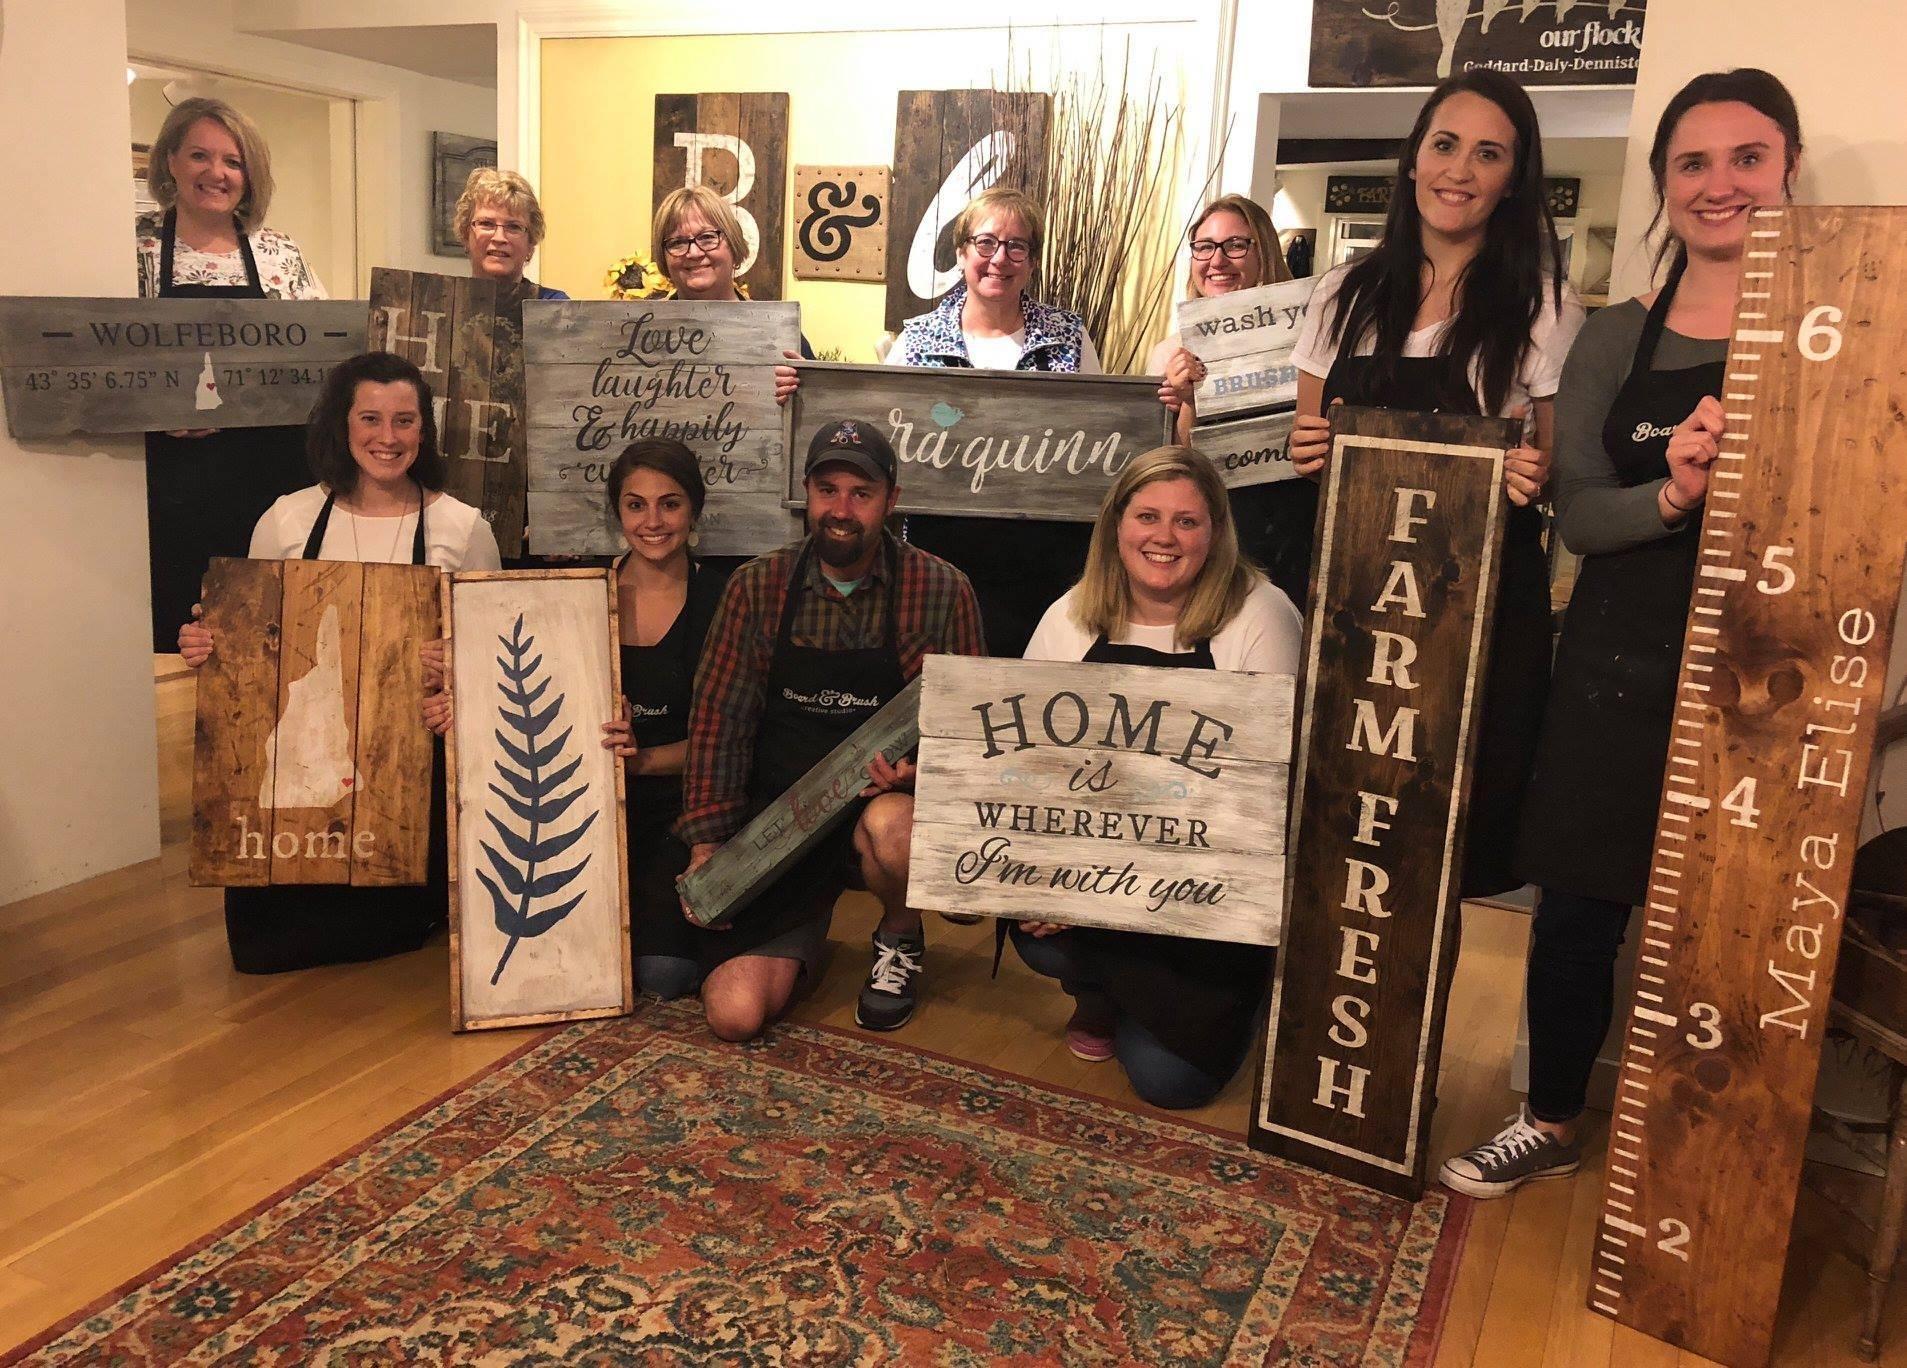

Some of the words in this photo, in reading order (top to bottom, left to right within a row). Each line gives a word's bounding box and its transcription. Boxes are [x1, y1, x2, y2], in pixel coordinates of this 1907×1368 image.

[1540, 30, 1580, 48] our
[673, 132, 760, 279] B
[799, 181, 881, 262] &
[89, 322, 308, 347] WOLFEBORO
[380, 306, 446, 374] H
[616, 312, 712, 368] Love
[1195, 305, 1277, 337] wash
[1797, 305, 1842, 361] 6
[165, 370, 179, 388] N
[592, 357, 737, 409] laughter
[572, 405, 616, 451] &
[620, 401, 750, 453] happily
[961, 427, 1132, 494] quinn
[1756, 545, 1796, 595] 5
[1346, 486, 1437, 762] FARM
[818, 689, 841, 706] &
[838, 693, 880, 707] Brush
[1797, 607, 1876, 798] Elise
[971, 690, 1234, 780] HOME
[1068, 759, 1118, 793] is
[974, 801, 1210, 848] WHEREVER
[1720, 776, 1761, 829] 4
[235, 815, 376, 860] home
[1049, 861, 1142, 897] with
[1145, 877, 1227, 913] you
[1312, 790, 1399, 1118] FRESH
[1759, 833, 1841, 1040] Maya
[1686, 1002, 1723, 1051] 3
[1656, 1218, 1691, 1262] 2
